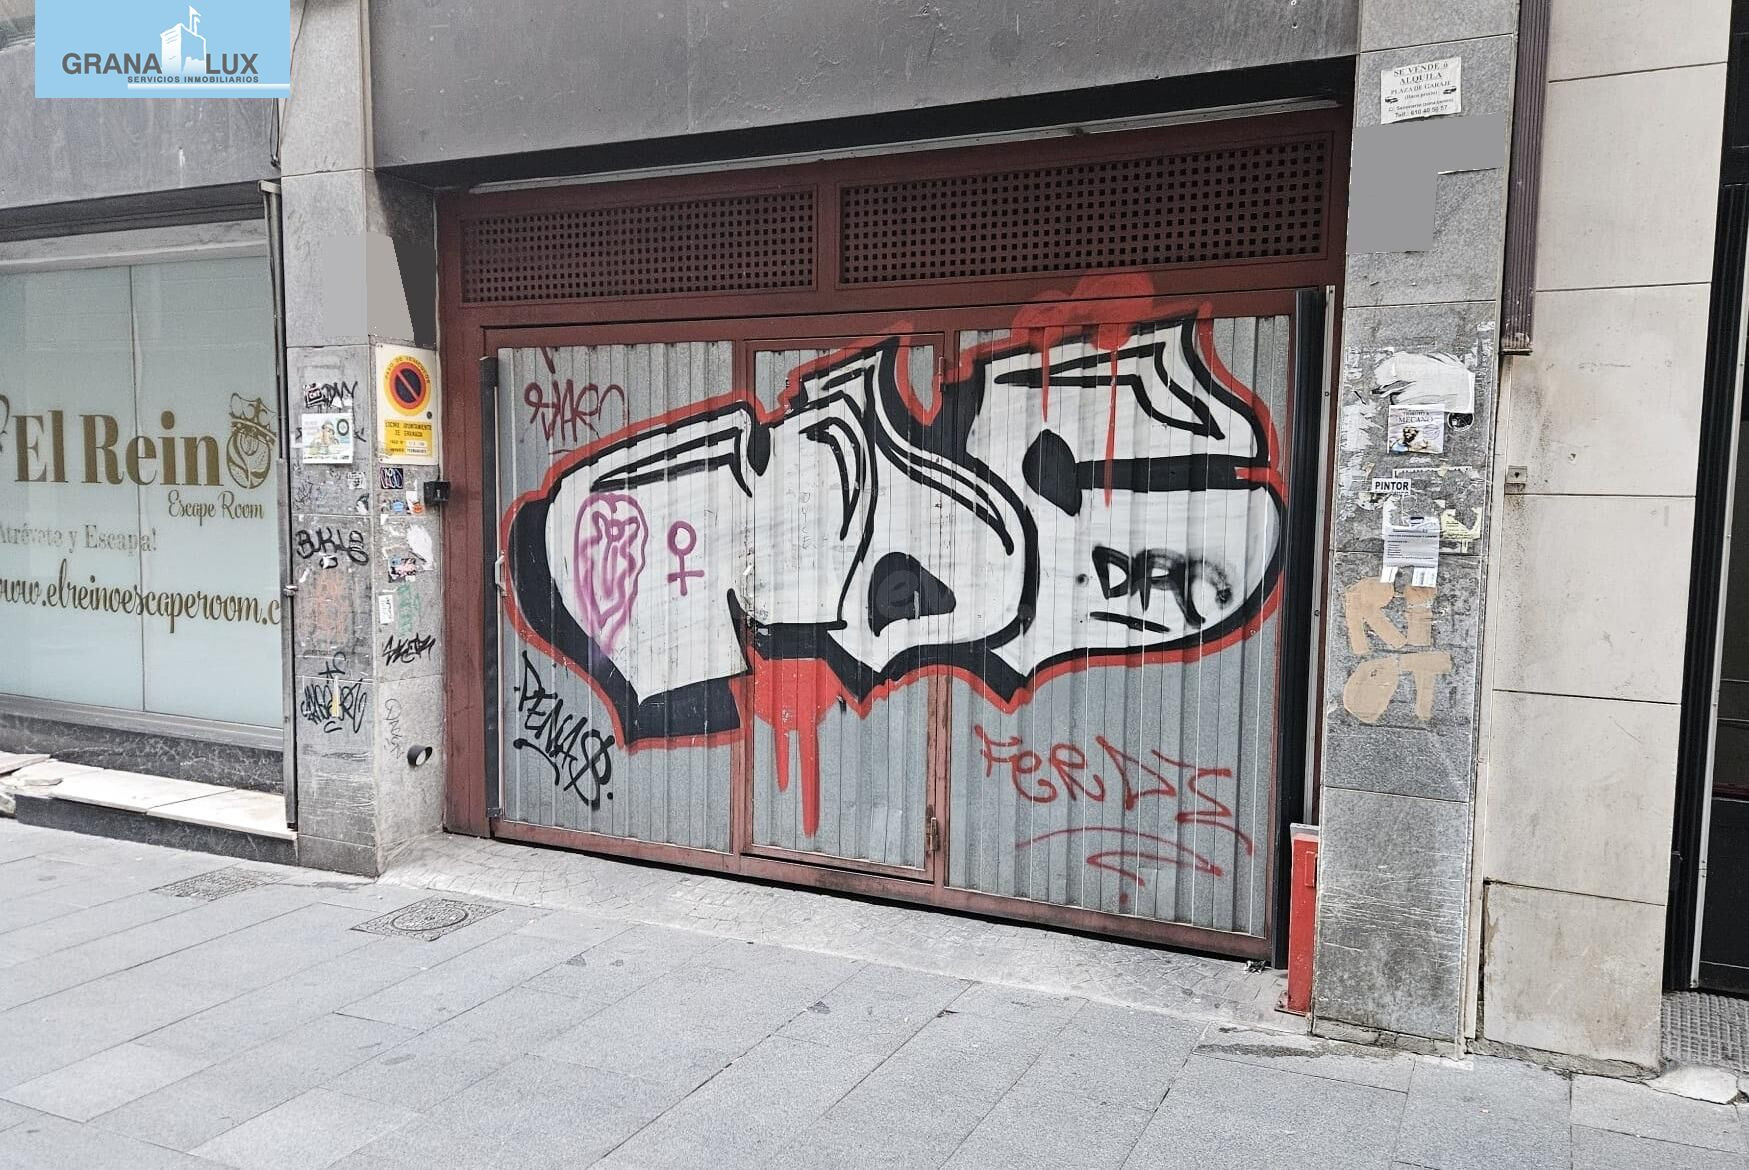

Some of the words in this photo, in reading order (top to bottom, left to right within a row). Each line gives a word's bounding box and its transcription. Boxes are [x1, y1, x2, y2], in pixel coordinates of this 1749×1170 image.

[1393, 68, 1405, 77] SE
[1408, 62, 1441, 74] VENDE
[1399, 71, 1443, 85] ALQUILA
[1391, 86, 1413, 95] PLAZA
[11, 409, 69, 483] El
[1375, 481, 1409, 491] PINTOR
[167, 489, 216, 527] Escape
[217, 490, 265, 520] Room
[68, 529, 78, 553] y
